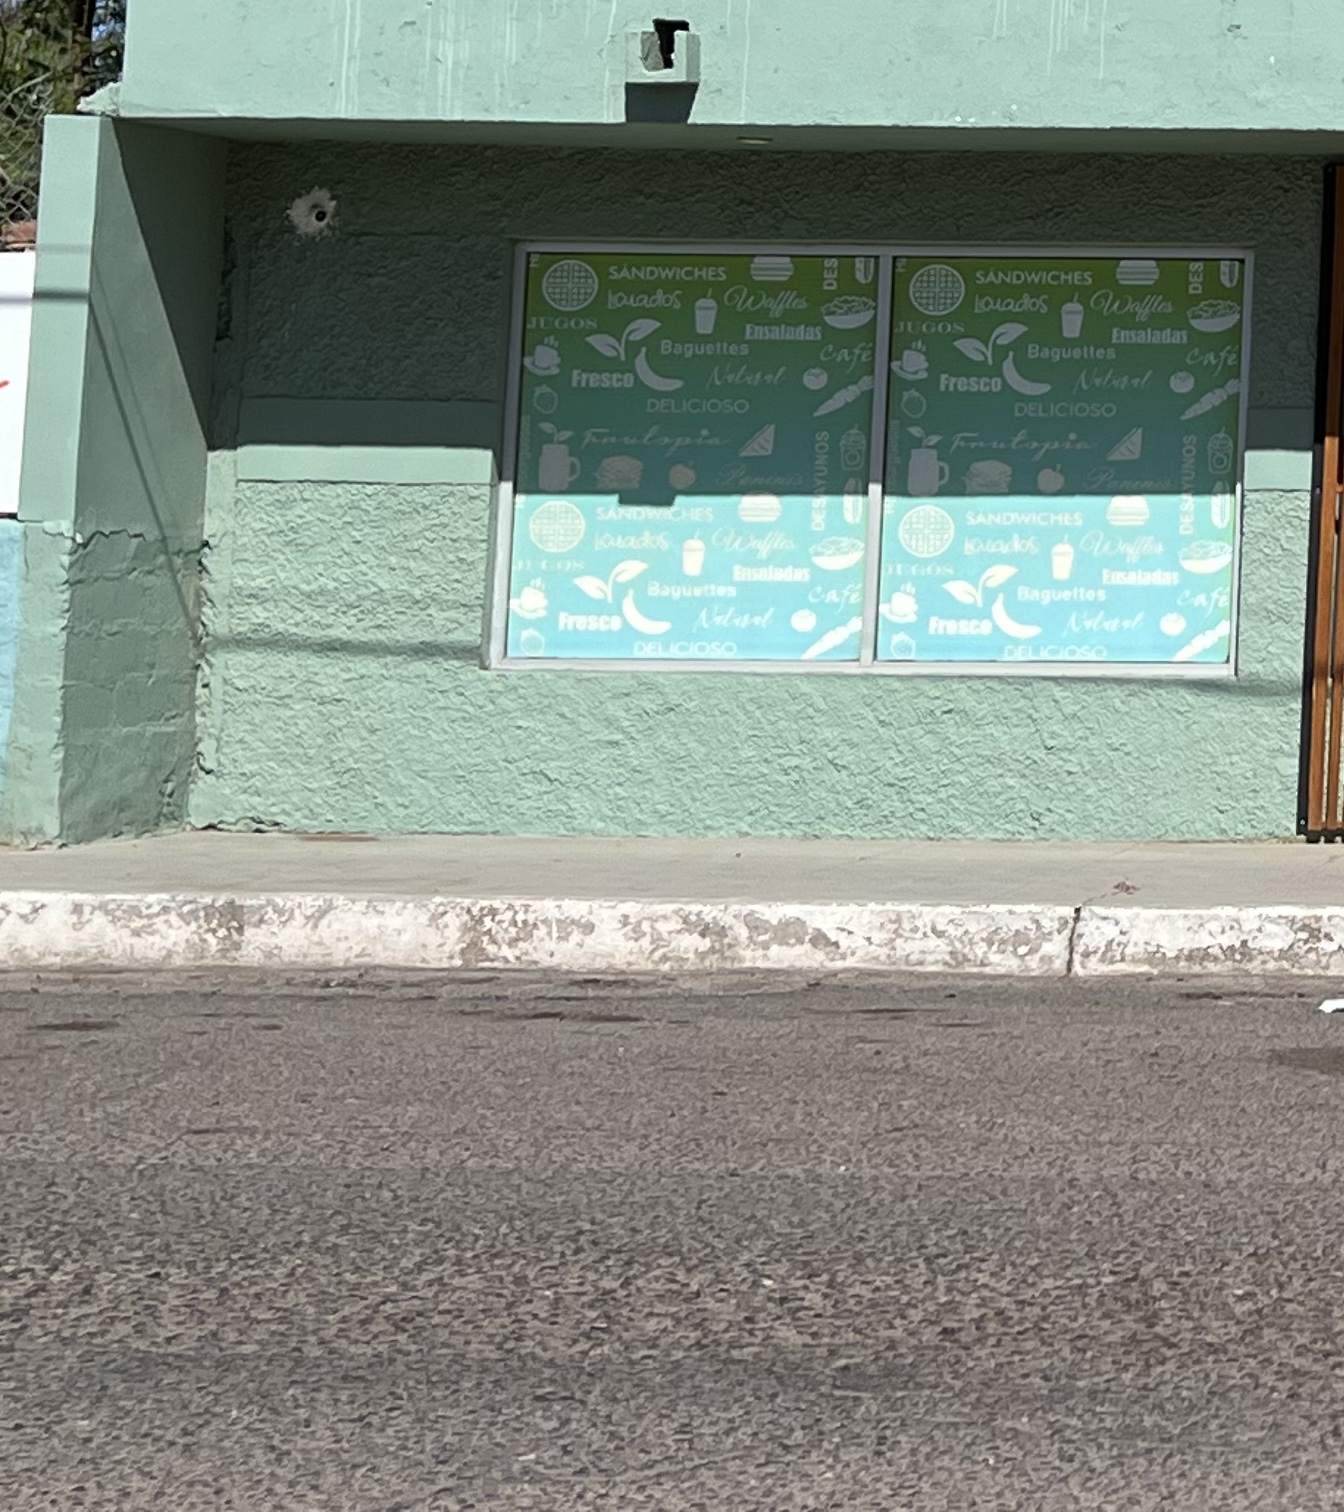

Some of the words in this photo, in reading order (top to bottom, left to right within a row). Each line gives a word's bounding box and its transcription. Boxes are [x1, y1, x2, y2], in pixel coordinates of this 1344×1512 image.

[745, 323, 823, 341] Ensaladas
[1111, 327, 1189, 344] Ensaladas
[660, 340, 750, 359] Baguettes
[1027, 343, 1117, 363] Baguettes
[571, 369, 635, 388] Fresco
[939, 373, 1001, 393] Fresco
[646, 397, 750, 414] DELICIOSO
[1013, 401, 1117, 418] DELICIOSO
[733, 564, 811, 582] Ensaladas
[1103, 569, 1179, 586] Ensaladas
[647, 581, 737, 600] Baguettes
[1018, 585, 1106, 605] Baguettes
[558, 610, 622, 632] Fresco
[928, 615, 993, 636] Fresco
[633, 640, 738, 657] DELICIOSO
[1004, 644, 1108, 661] DELICIOSO
